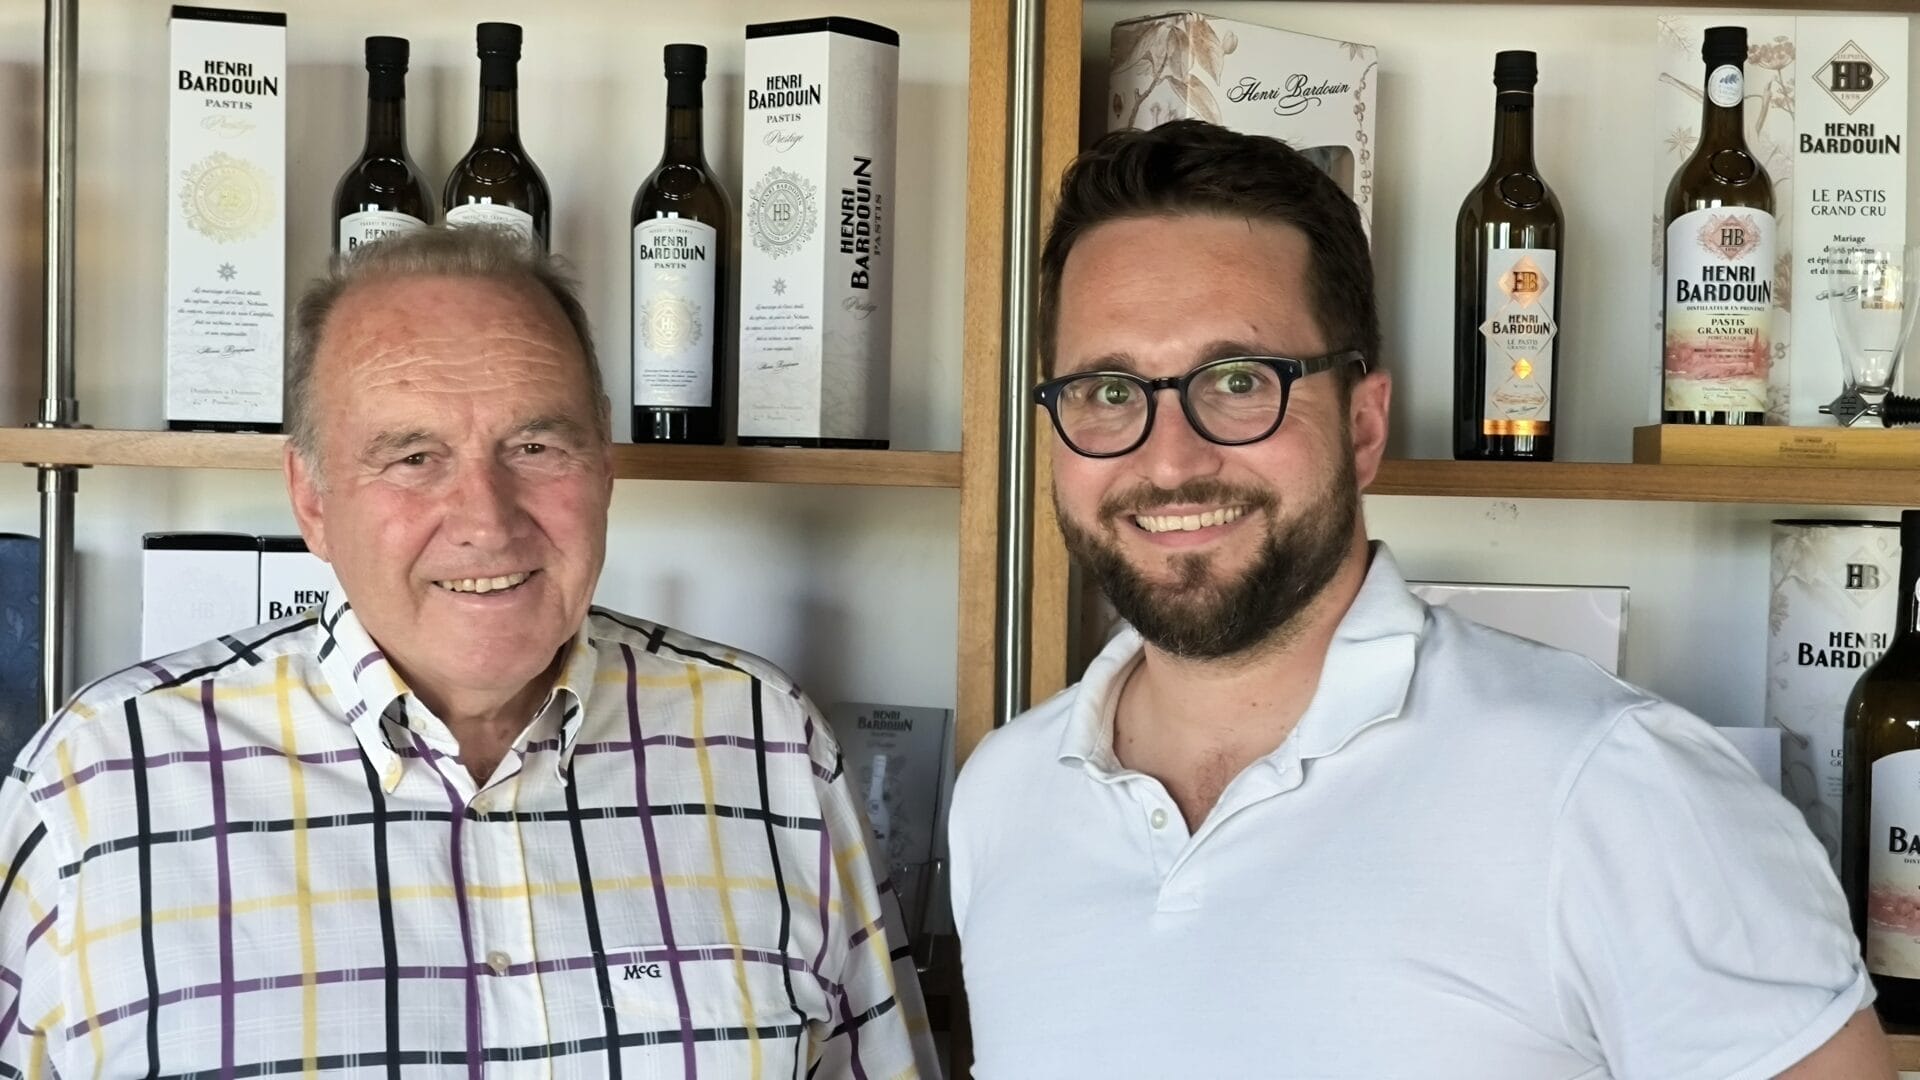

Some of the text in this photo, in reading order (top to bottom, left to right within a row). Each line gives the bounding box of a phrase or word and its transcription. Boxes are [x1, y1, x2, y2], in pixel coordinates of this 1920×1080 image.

[204, 60, 253, 77] HENRI
[1831, 60, 1874, 92] HB
[178, 70, 278, 96] BARDOUIN
[767, 74, 802, 90] HENRI
[749, 84, 821, 109] BARDOUIN
[1227, 73, 1351, 116] Henri Bardouin
[205, 99, 253, 110] PASTIS
[766, 115, 802, 123] PASTIS
[1824, 123, 1874, 137] HENRI
[1800, 133, 1901, 154] BARDOUIN
[1812, 189, 1886, 203] LE PASTIS
[773, 203, 791, 221] HB
[1811, 205, 1887, 216] GRAND CRU
[840, 189, 855, 254] HENRI
[851, 156, 872, 290] BARDOUIN
[874, 193, 883, 256] PASTIS
[653, 236, 687, 247] HENRI
[1720, 228, 1744, 246] HB
[1833, 234, 1866, 244] Mariage
[640, 245, 705, 261] BARDOUIN
[1512, 271, 1539, 293] HB
[1702, 265, 1755, 283] HENRI
[1677, 279, 1771, 304] BARDOUIN
[1508, 314, 1539, 324] HENRI
[1711, 318, 1745, 326] PASTIS
[1492, 321, 1551, 335] BARDOUIN
[1697, 327, 1736, 335] GRAND
[1845, 563, 1880, 589] HB
[1829, 631, 1887, 648] HENRI
[1798, 642, 1884, 668] BARDO
[623, 964, 662, 980] McG
